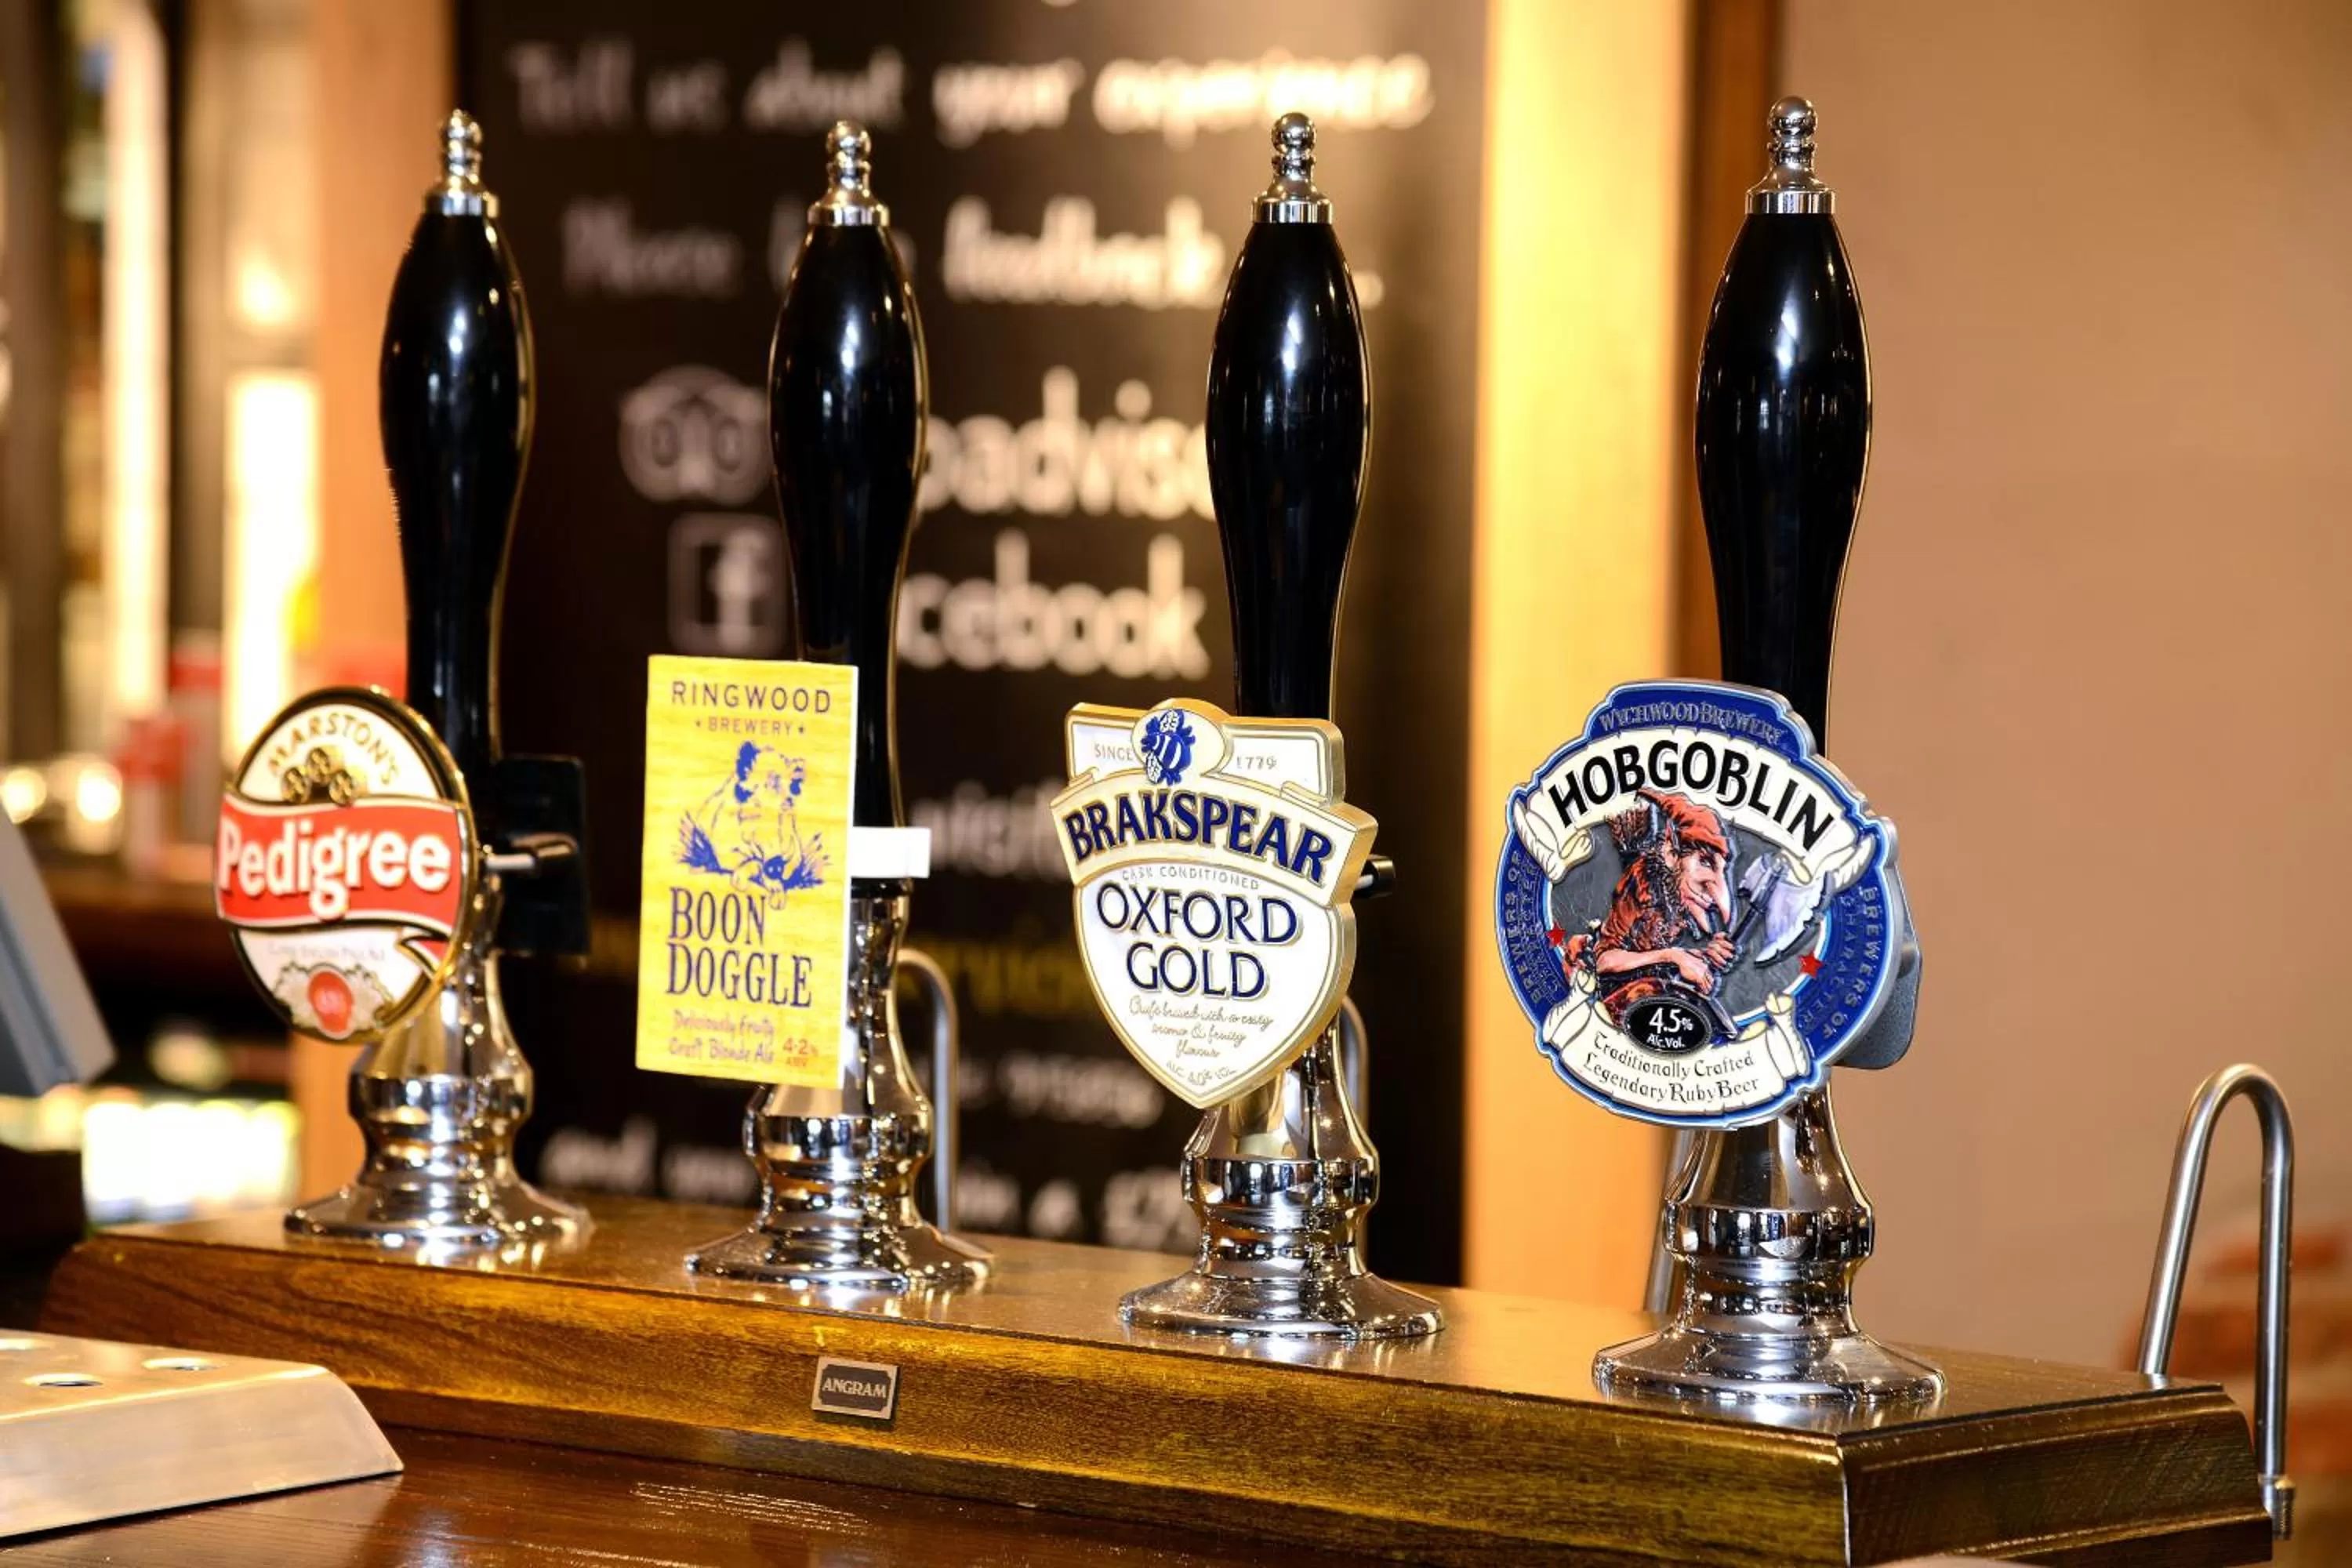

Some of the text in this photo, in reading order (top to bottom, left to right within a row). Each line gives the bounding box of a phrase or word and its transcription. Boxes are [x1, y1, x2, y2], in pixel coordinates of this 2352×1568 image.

[896, 527, 1211, 680] cebook
[672, 681, 830, 713] RINGWOOD
[1599, 702, 1700, 732] WYCHWOOD
[708, 717, 793, 735] BREWERY
[1094, 743, 1134, 760] SINCE
[1548, 739, 1835, 852] HOBGOBLIN
[1062, 789, 1335, 887] BRAKSPEAR
[218, 816, 452, 919] Pedigree
[1160, 866, 1260, 890] CONDITIONED
[667, 887, 766, 946] BOON
[1098, 882, 1299, 945] OXFORD
[1126, 941, 1266, 999] GOLD
[1845, 886, 1882, 1007] BREWERS
[666, 942, 812, 1007] DOGGLE
[1649, 1007, 1693, 1034] 4.5%
[1584, 1052, 1759, 1104] Legendary Ruby Beer
[1594, 1031, 1755, 1080] Traditionally Crafted
[822, 1377, 887, 1399] ANGRAM
